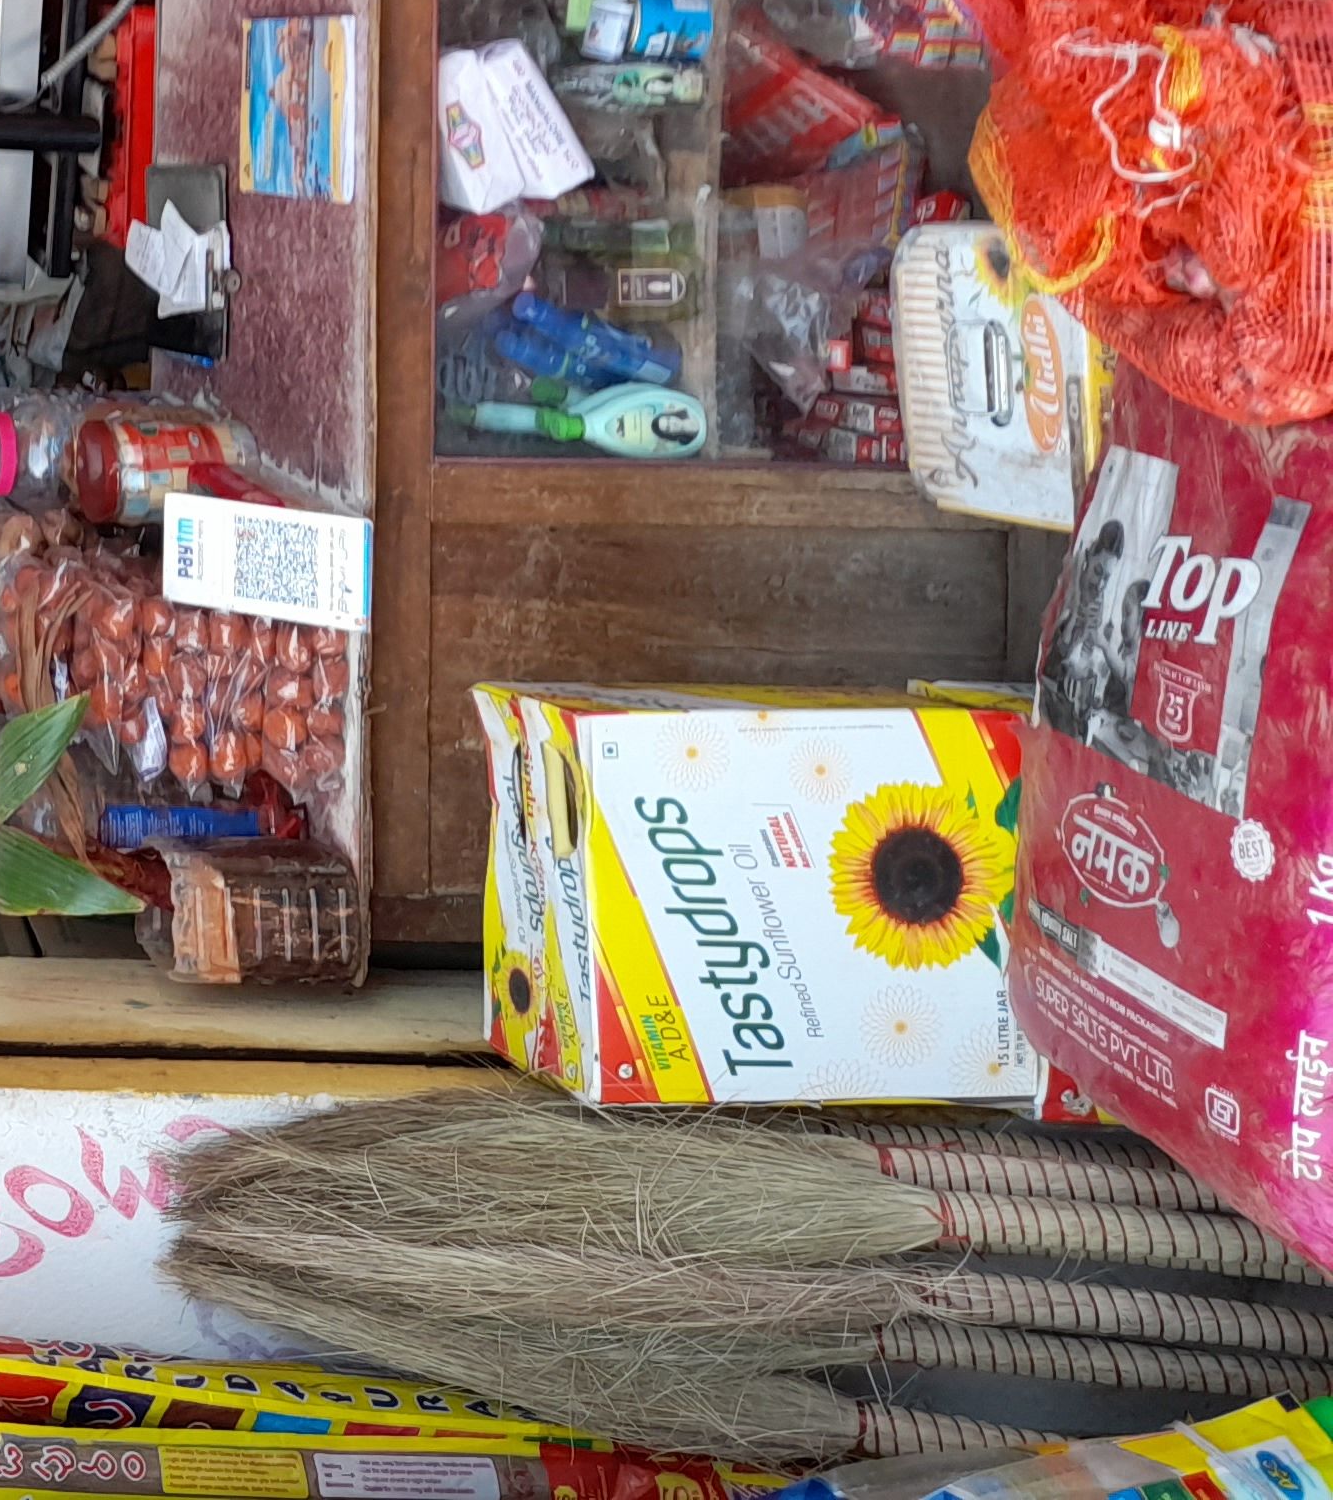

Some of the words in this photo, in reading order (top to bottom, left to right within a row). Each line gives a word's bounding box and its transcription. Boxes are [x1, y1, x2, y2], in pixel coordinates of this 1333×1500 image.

[175, 516, 194, 580] paytm
[1143, 617, 1194, 643] LINE
[727, 842, 760, 871] Oil
[765, 813, 799, 869] NATURAL
[1070, 818, 1155, 898] नमक
[1236, 839, 1268, 862] BEST
[544, 835, 591, 1004] Tastydrop
[633, 794, 794, 1076] Tastydrops
[746, 879, 807, 982] Sunflower
[787, 982, 826, 1039] Refined
[995, 989, 1009, 1014] JAR
[1032, 977, 1070, 1018] SUPER
[1070, 1012, 1110, 1050] SALTS
[638, 1013, 673, 1072] VITAMIN
[997, 1015, 1010, 1050] LITRE
[997, 1053, 1010, 1068] 15
[1287, 1029, 1332, 1117] लाईन
[1283, 1121, 1327, 1182] टोप
